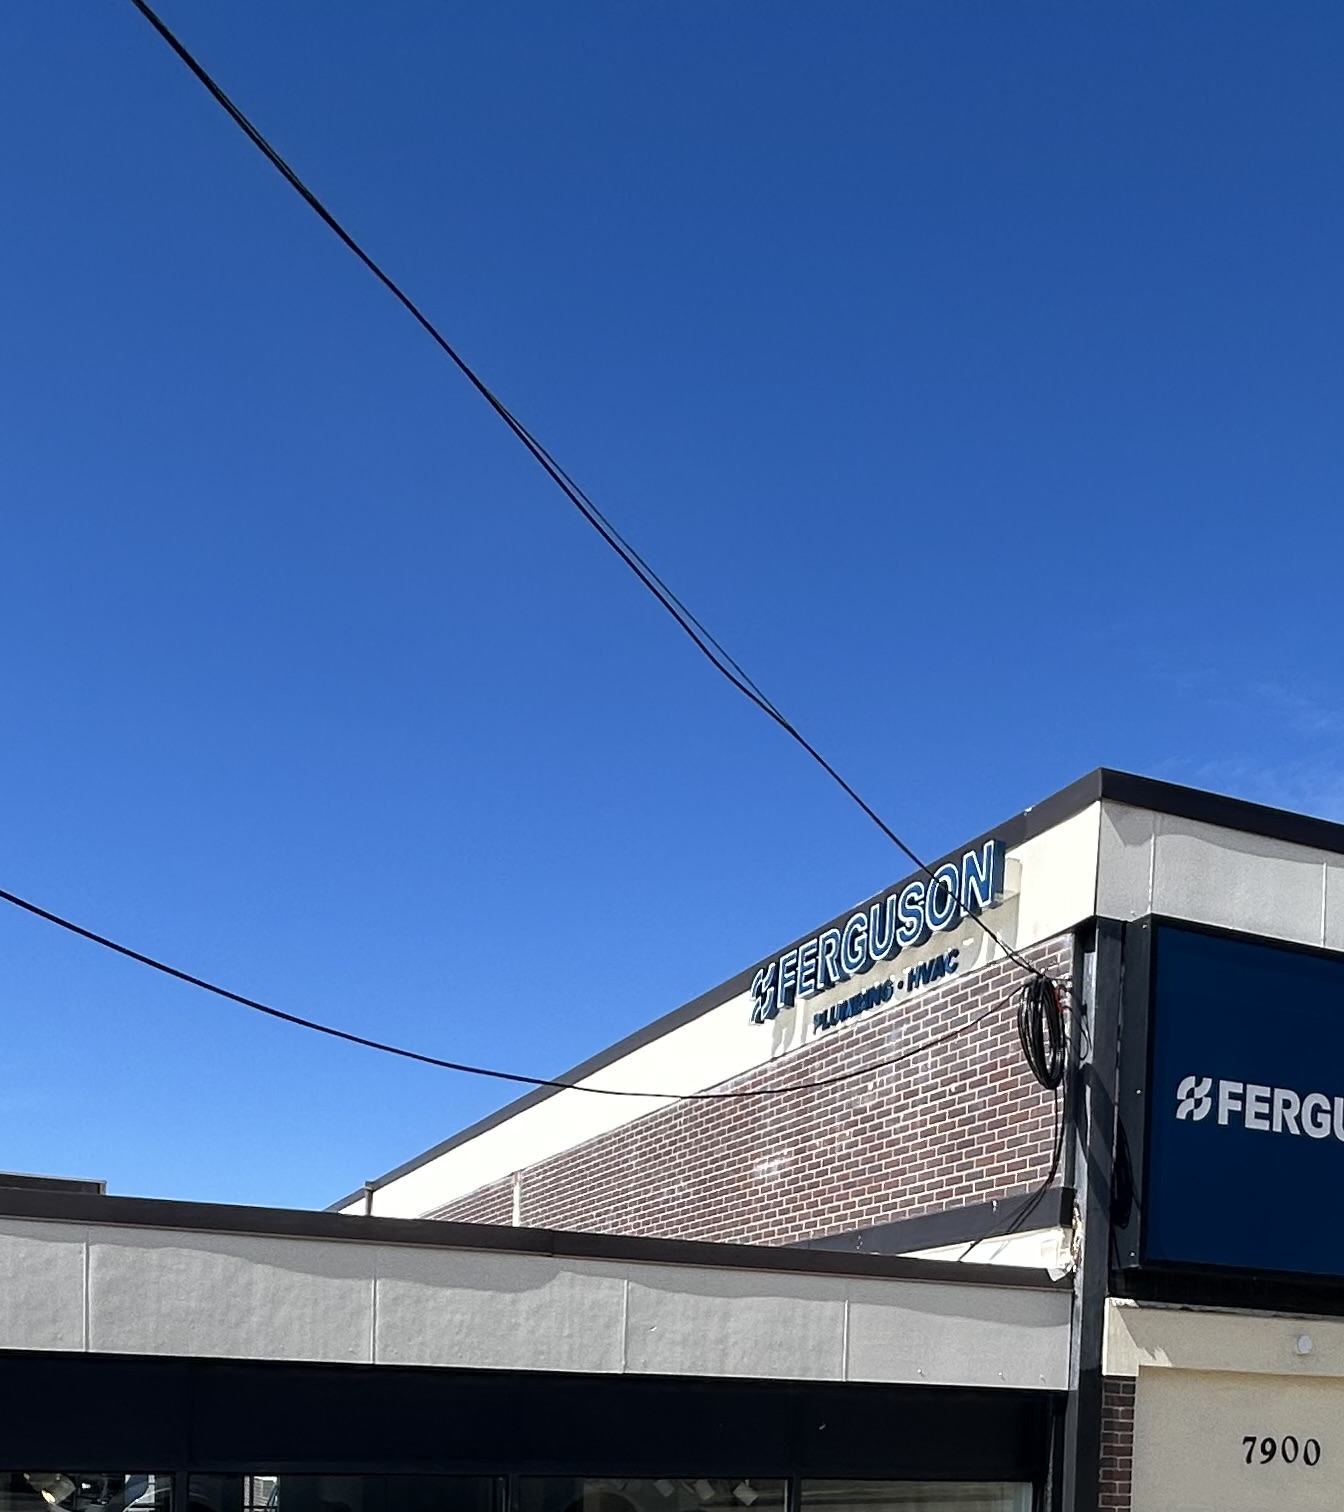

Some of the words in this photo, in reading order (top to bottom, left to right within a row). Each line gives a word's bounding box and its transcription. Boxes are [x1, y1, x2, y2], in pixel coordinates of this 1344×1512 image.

[775, 839, 1005, 1009] FERGUSON
[907, 949, 960, 992] HVAC
[1242, 1434, 1321, 1466] 7900
